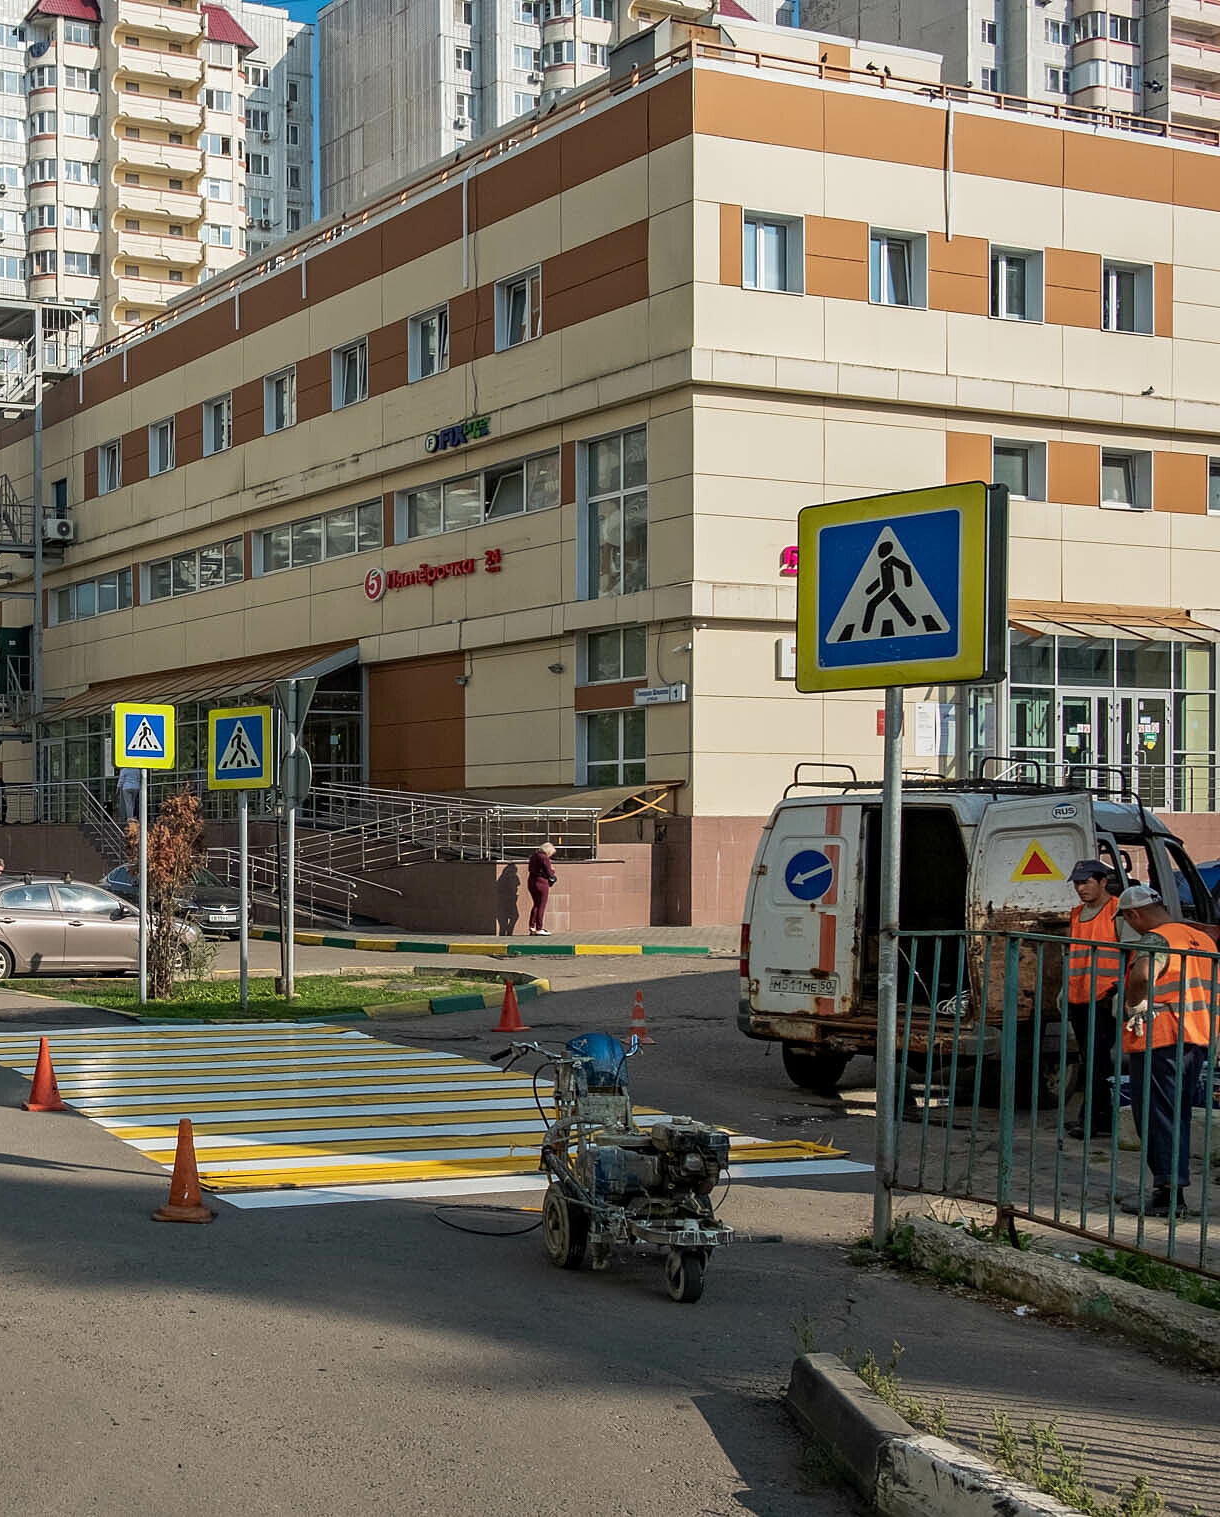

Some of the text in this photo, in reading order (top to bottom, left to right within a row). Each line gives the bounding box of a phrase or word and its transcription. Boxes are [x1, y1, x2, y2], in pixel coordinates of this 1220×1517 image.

[368, 575, 378, 594] 5
[386, 558, 476, 587] Пятёрочка
[1055, 807, 1075, 816] RUS
[820, 981, 832, 990] 50
